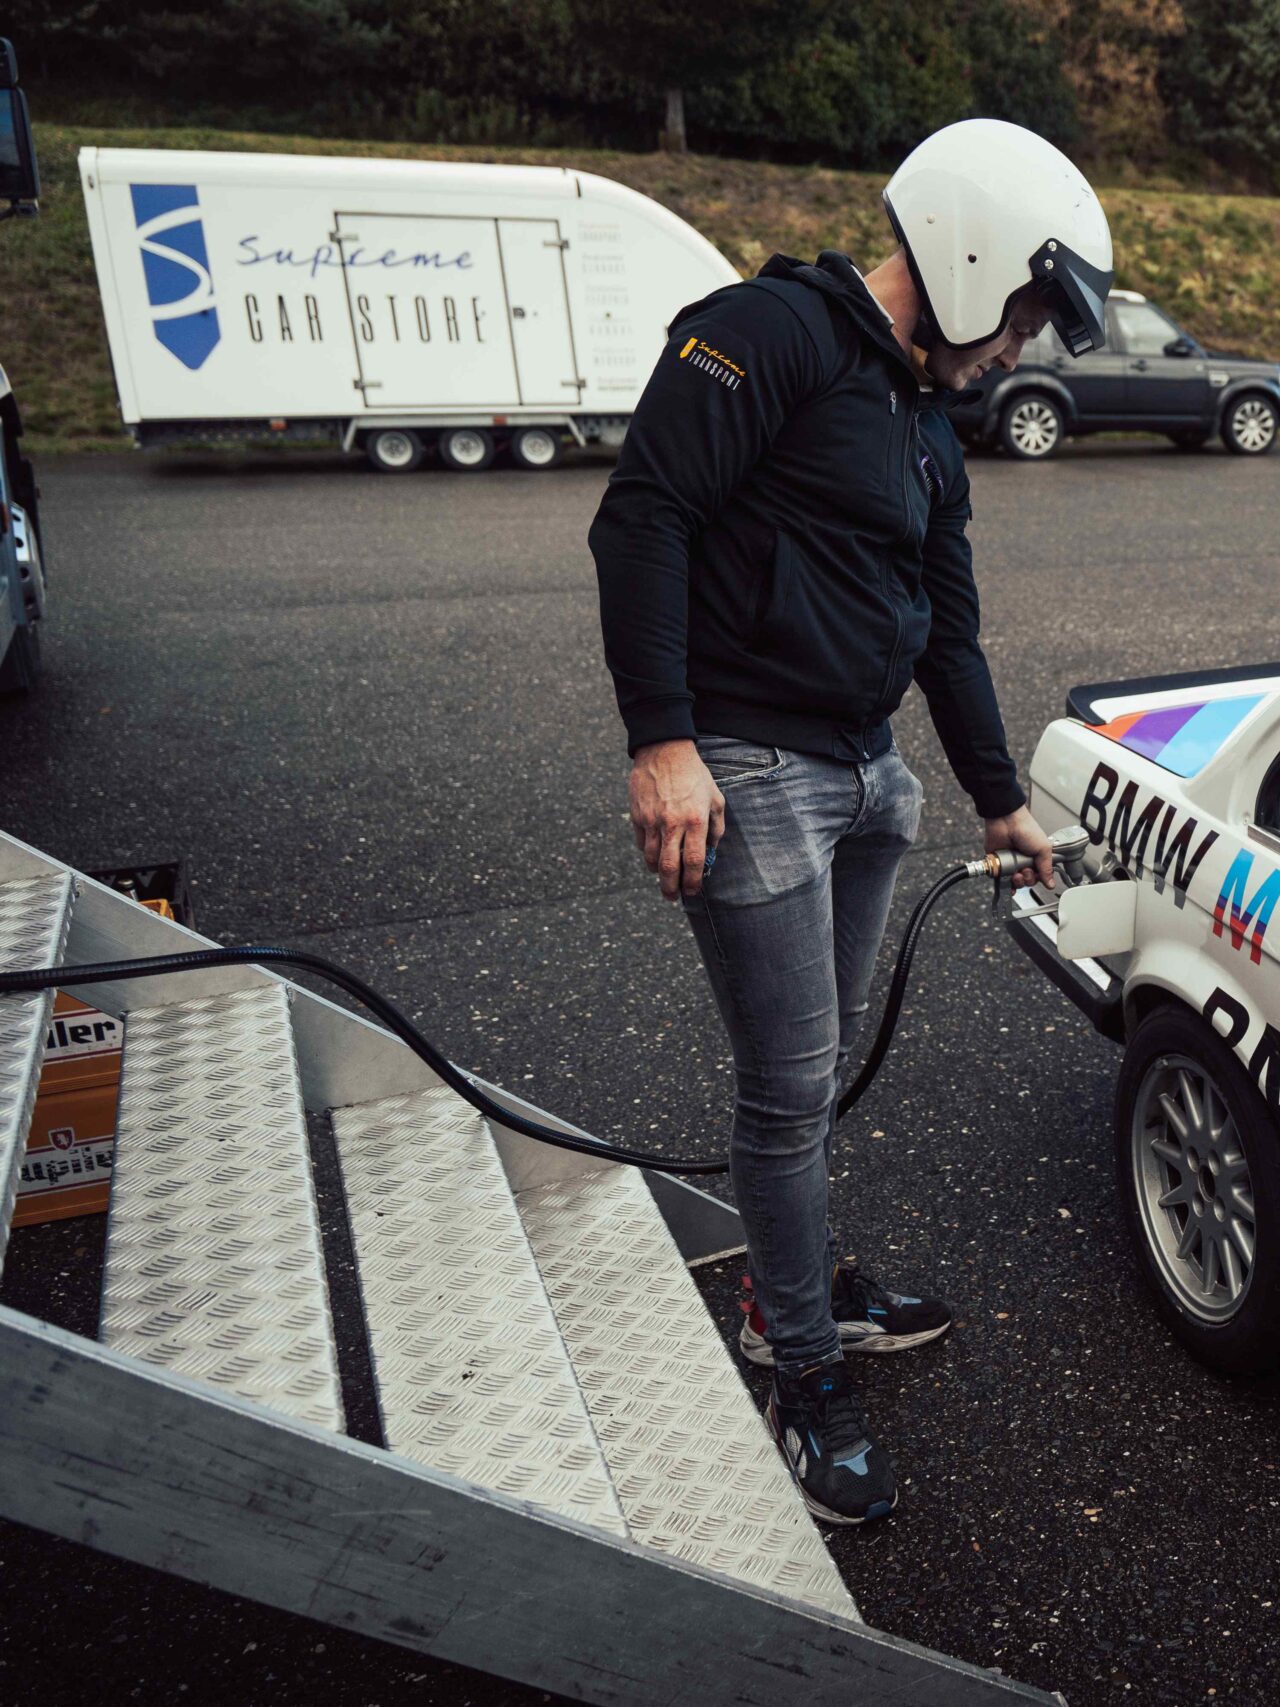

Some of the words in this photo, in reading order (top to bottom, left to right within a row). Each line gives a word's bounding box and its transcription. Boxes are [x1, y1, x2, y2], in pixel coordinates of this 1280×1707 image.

[236, 235, 474, 278] Supreme
[244, 293, 323, 343] CAR
[356, 293, 487, 343] STORE
[688, 351, 741, 391] TRANSPORT
[698, 341, 746, 377] Supreme
[1079, 761, 1220, 911] BMW
